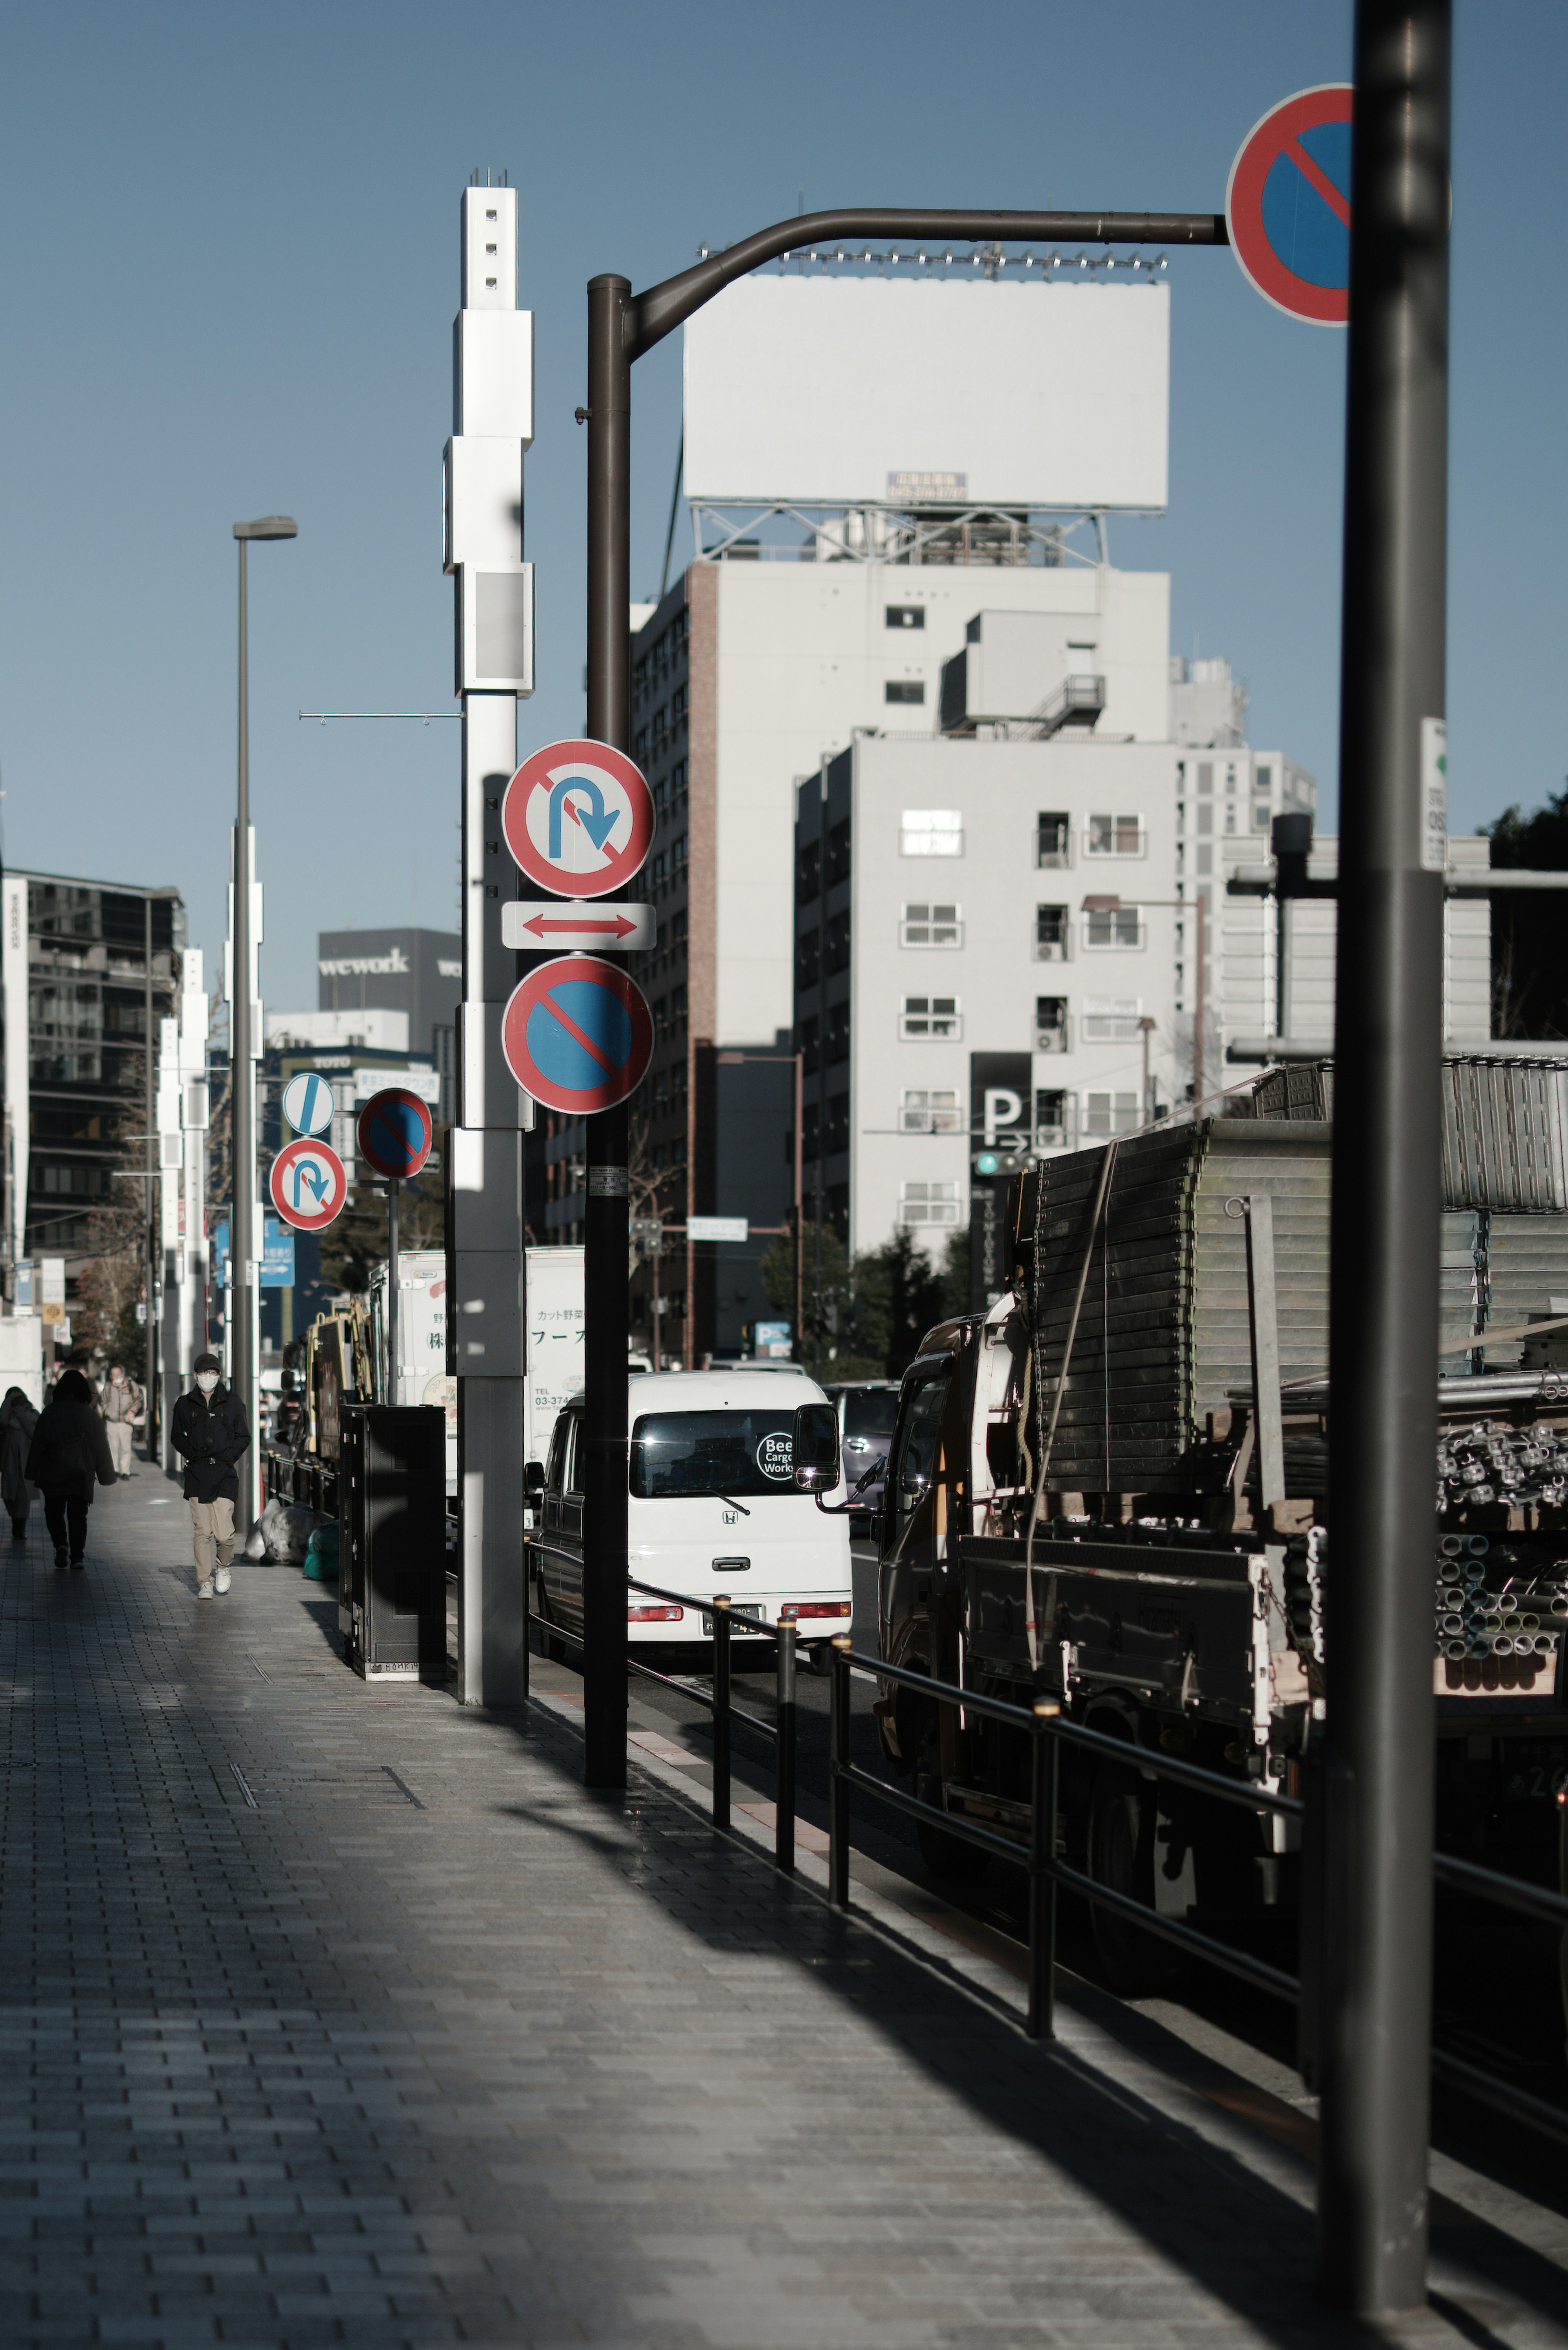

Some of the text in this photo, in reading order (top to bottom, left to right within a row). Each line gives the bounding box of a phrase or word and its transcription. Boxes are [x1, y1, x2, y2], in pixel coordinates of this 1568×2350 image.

[320, 948, 409, 976] wework
[313, 1056, 351, 1068] TOTO
[984, 1088, 1022, 1146] P
[538, 1310, 584, 1320] カット野菜
[759, 1327, 772, 1344] P
[766, 1439, 792, 1452] Bee
